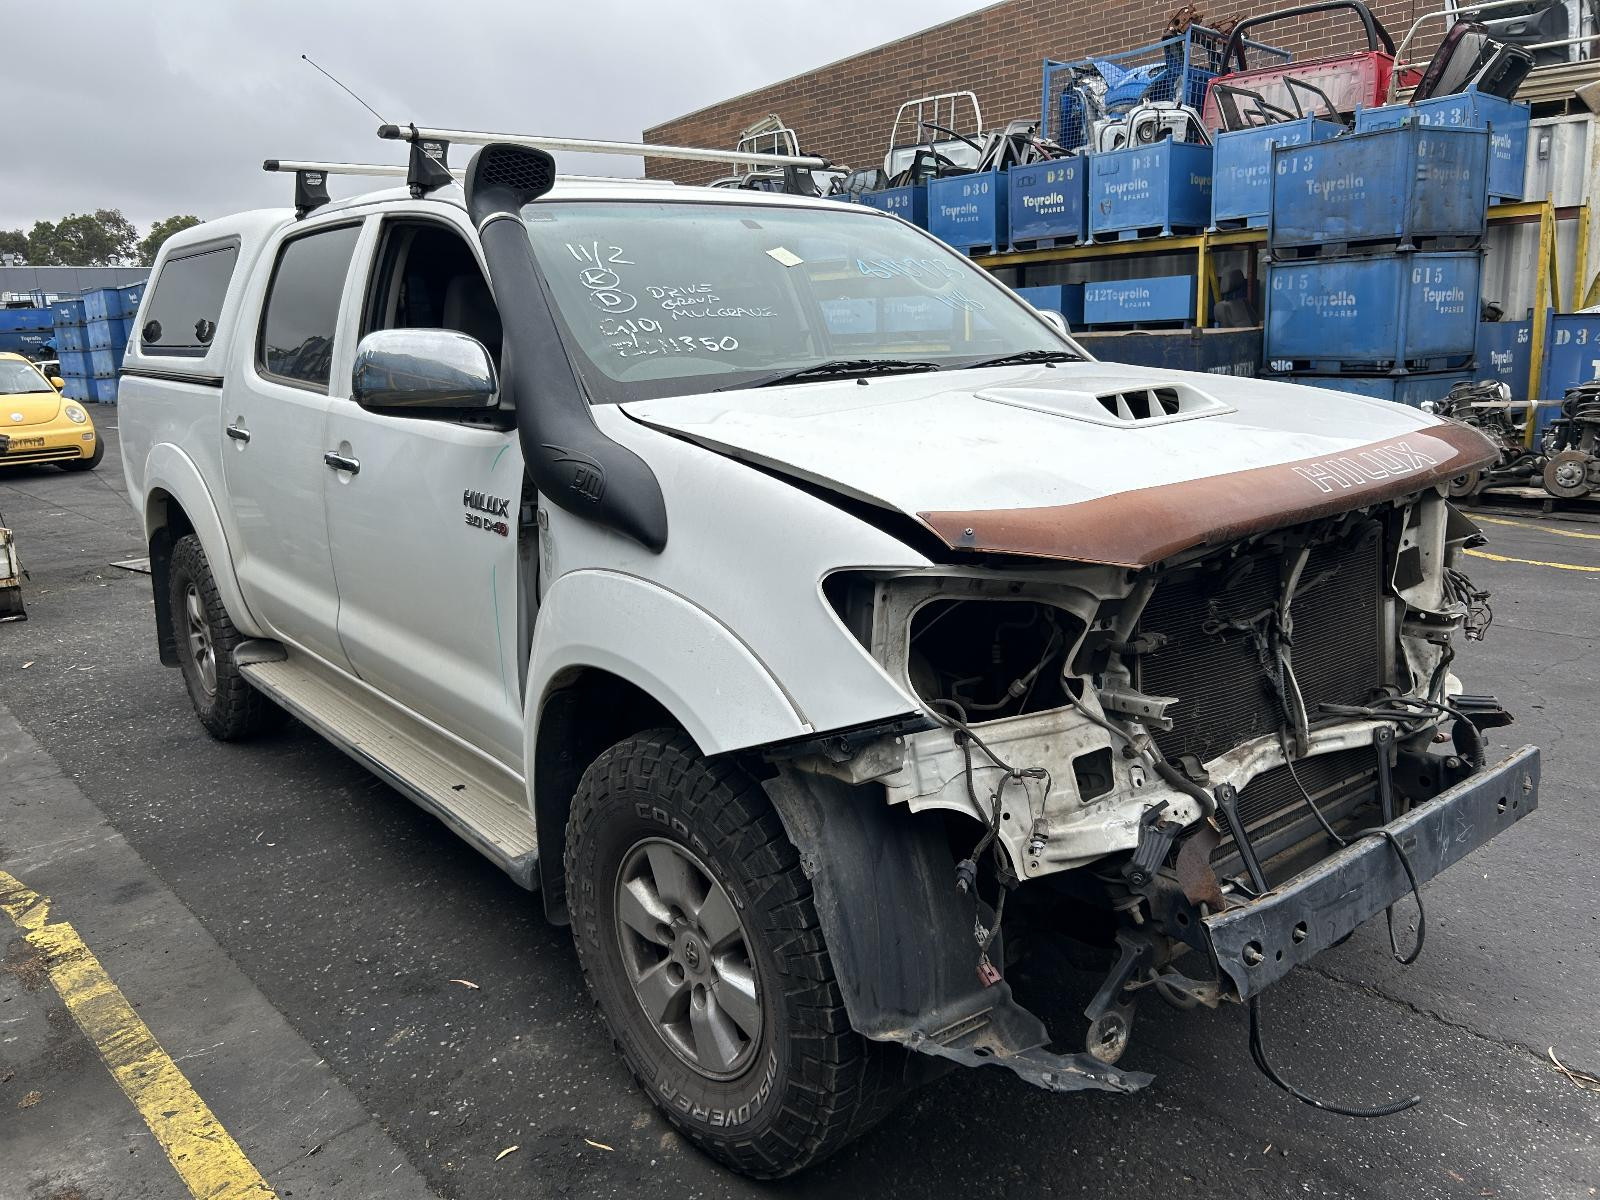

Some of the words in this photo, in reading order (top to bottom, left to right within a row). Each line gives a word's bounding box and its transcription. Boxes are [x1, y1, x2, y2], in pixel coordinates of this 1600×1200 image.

[1132, 154, 1160, 172] D31
[1277, 155, 1313, 175] G13
[1047, 167, 1075, 184] D29
[1230, 162, 1270, 185] Toyrol
[963, 182, 989, 197] D30
[1104, 178, 1148, 199] Toyrolla
[887, 195, 908, 209] D28
[1022, 192, 1064, 213] Toyrolla
[940, 202, 978, 221] Toyrolla
[1040, 206, 1065, 216] SPARES
[956, 216, 980, 224] SPARES
[565, 241, 635, 269] 11/2
[1273, 274, 1308, 290] G15
[1412, 267, 1443, 284] G15
[646, 283, 713, 299] DRIVE
[1085, 289, 1106, 303] G12
[1423, 286, 1464, 311] Toyrolla
[661, 294, 720, 310] GROUP
[1300, 291, 1356, 314] Toyrolla
[671, 306, 778, 320] MULGRAVE
[1517, 328, 1529, 343] 55
[1291, 441, 1437, 494] HILUX
[463, 488, 510, 518] HILUX
[658, 1050, 778, 1127] DISCOVERER
